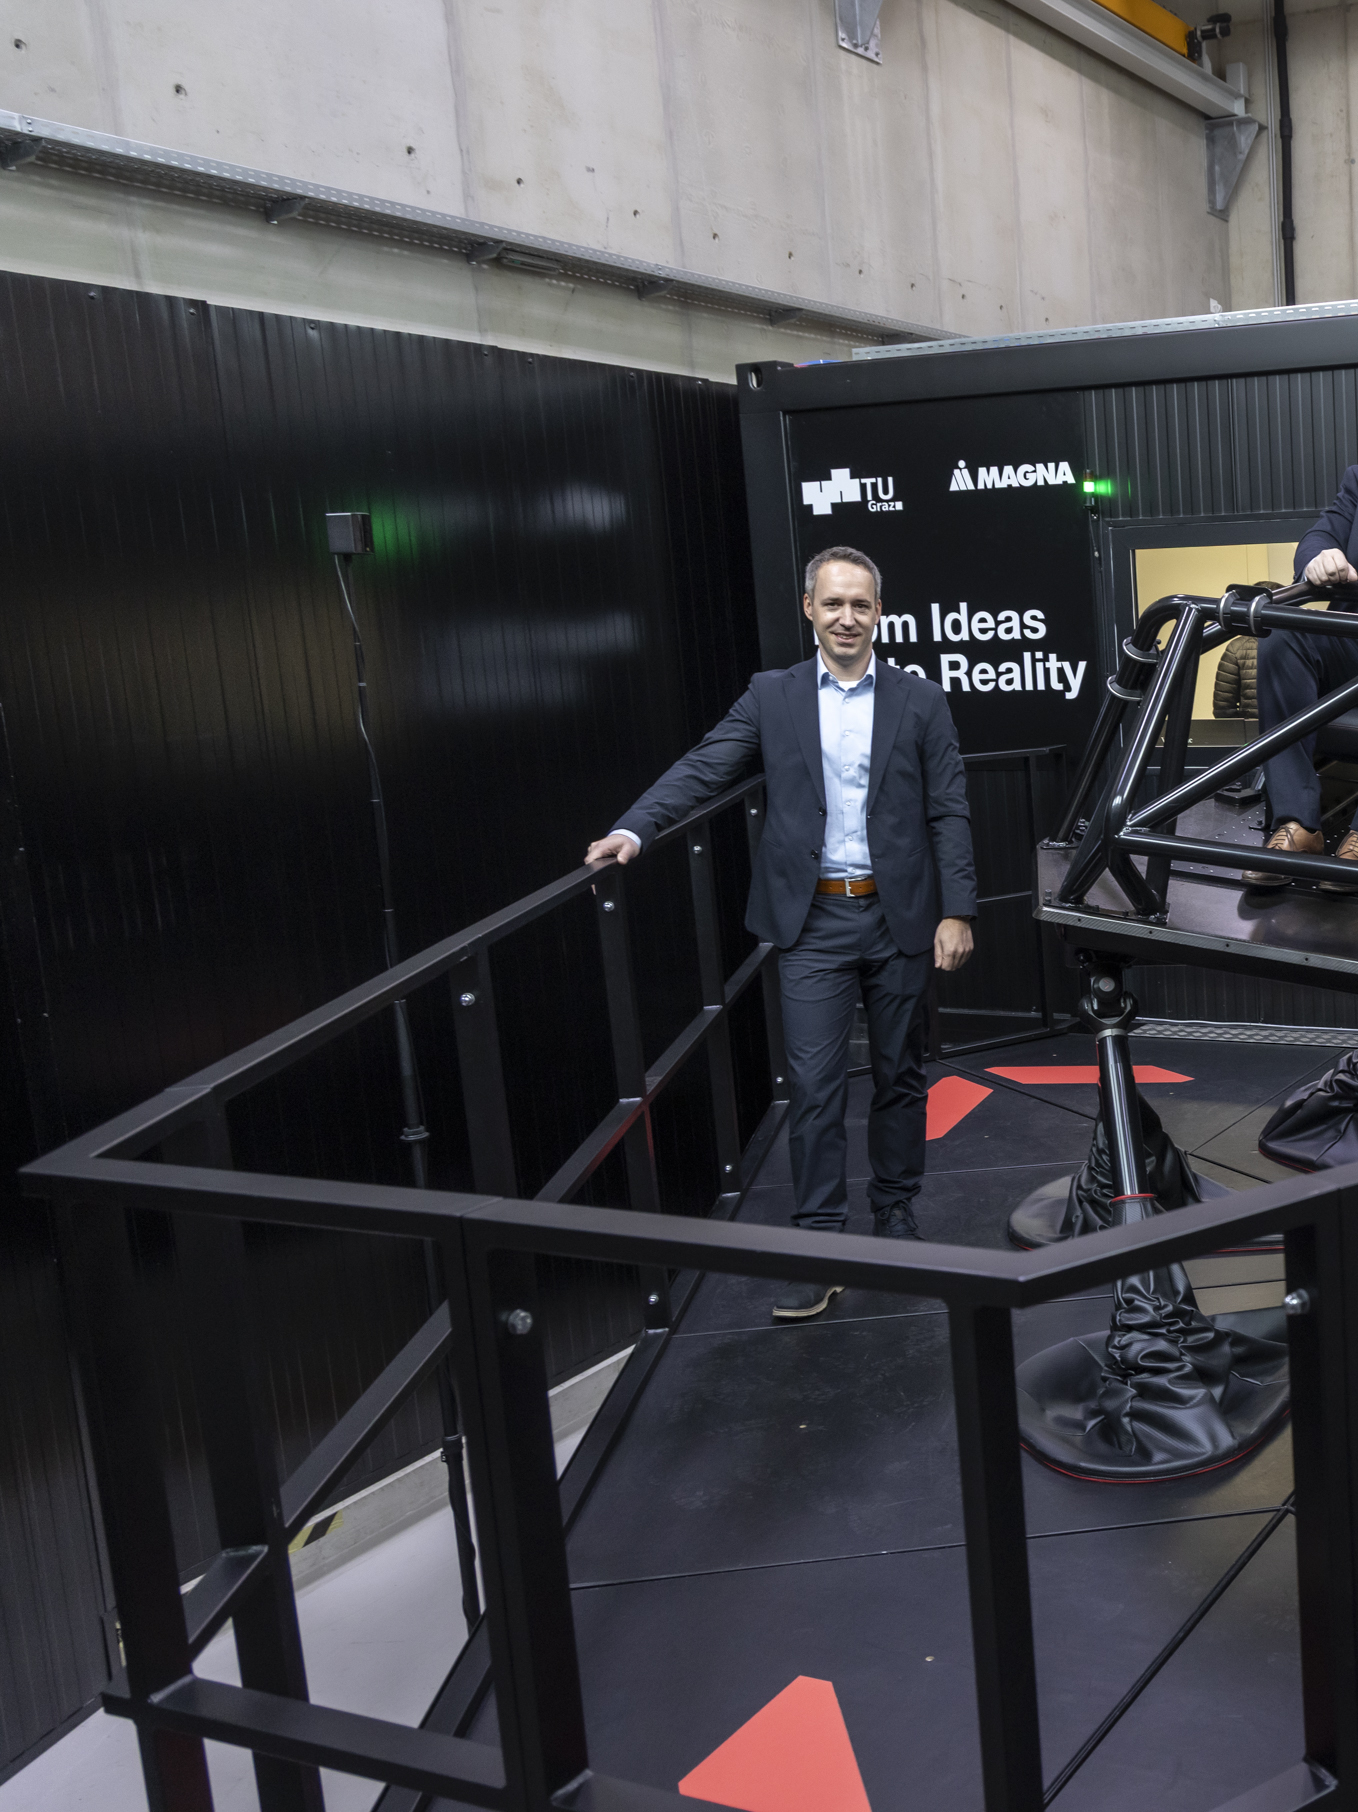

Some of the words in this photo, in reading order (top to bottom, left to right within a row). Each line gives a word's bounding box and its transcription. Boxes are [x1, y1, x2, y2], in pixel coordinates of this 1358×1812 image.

[860, 476, 894, 501] TU
[977, 461, 1076, 489] MAGNA
[867, 500, 895, 512] Graz
[930, 601, 1047, 642] Ideas
[939, 651, 1087, 700] Reality
